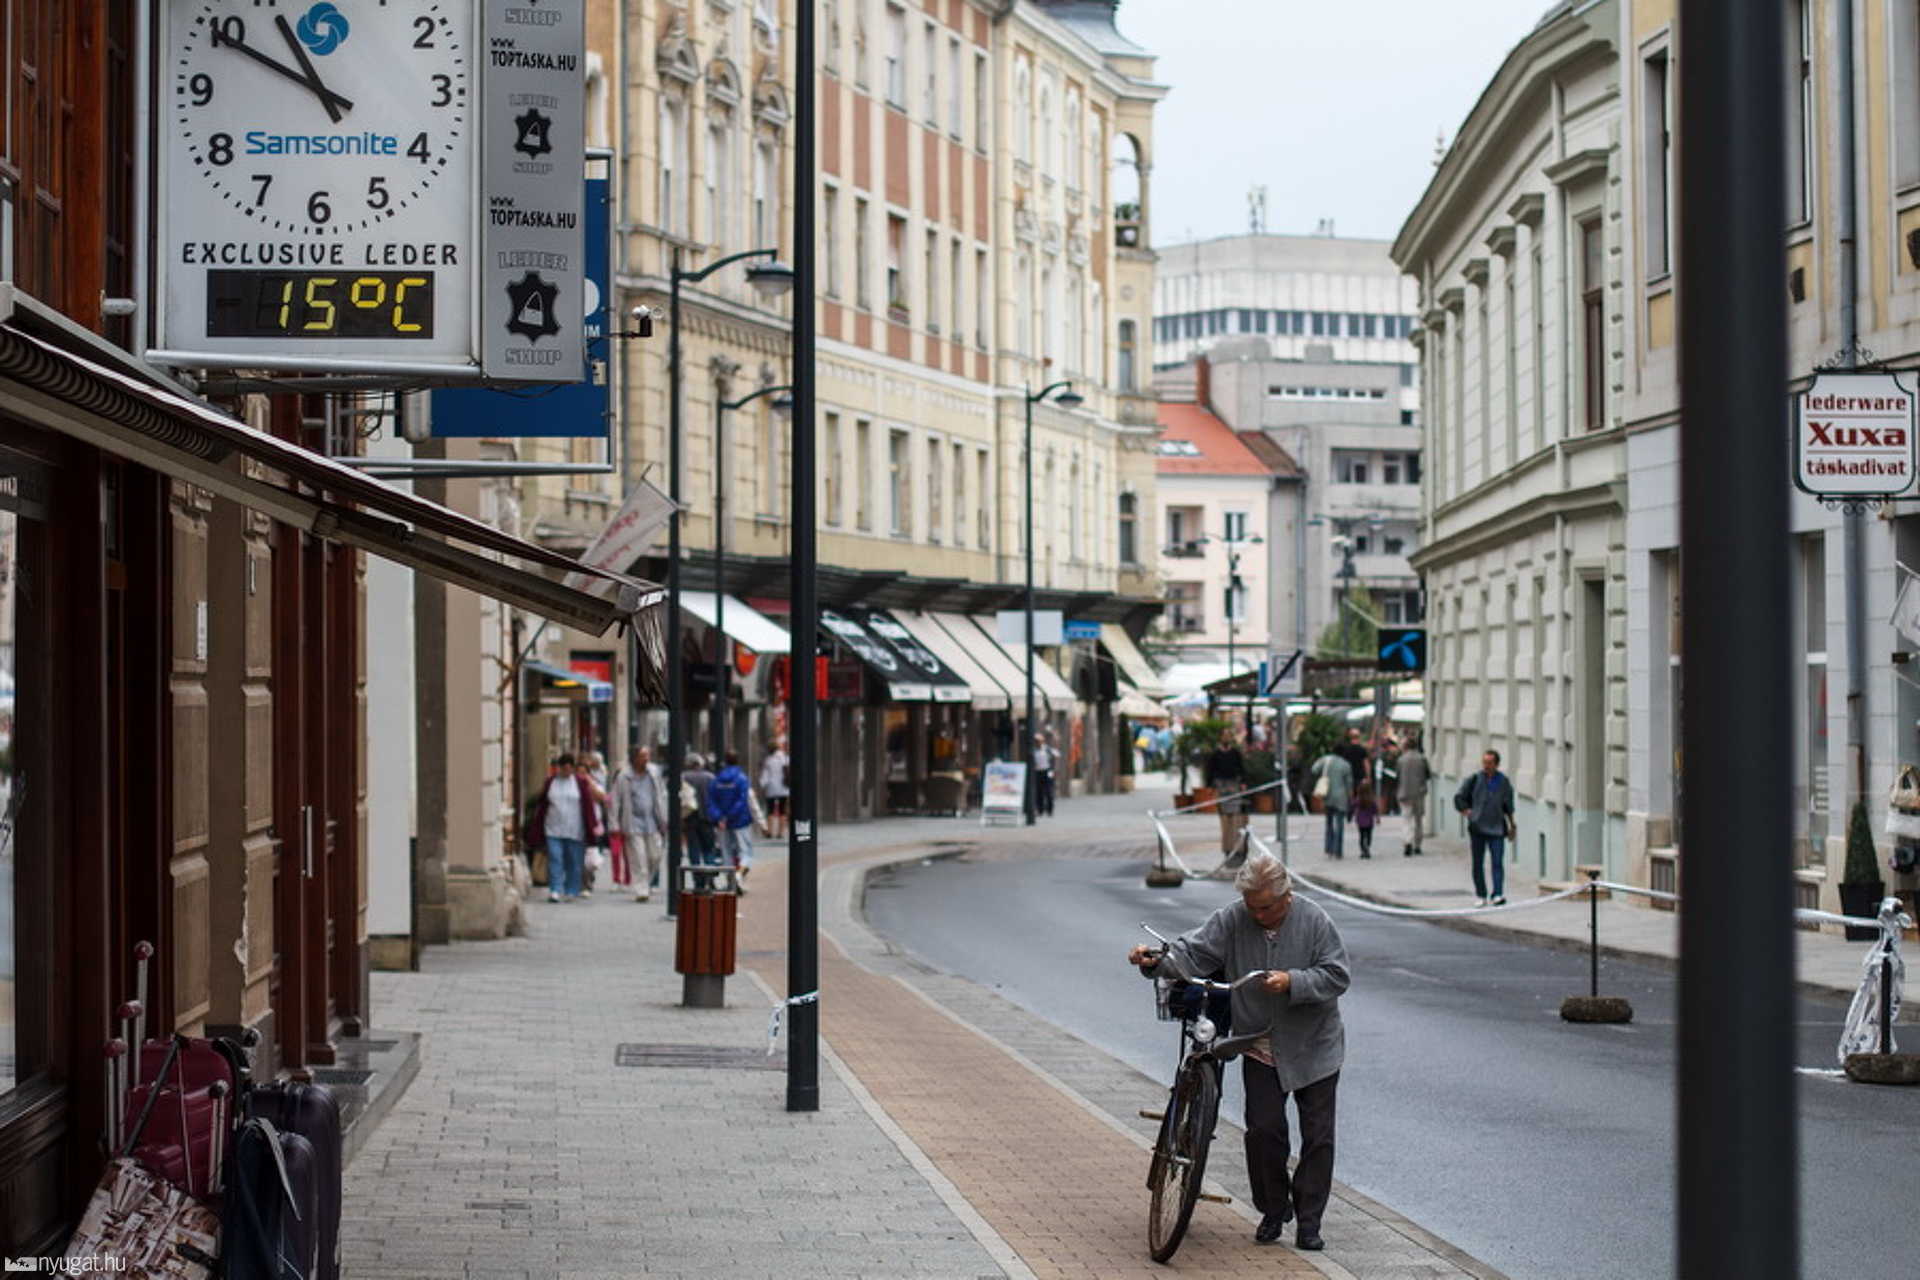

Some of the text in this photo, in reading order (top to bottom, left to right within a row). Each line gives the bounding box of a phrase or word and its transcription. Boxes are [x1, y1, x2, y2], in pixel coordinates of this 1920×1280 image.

[209, 15, 246, 48] 10
[413, 16, 435, 49] 2
[491, 51, 577, 71] TOPTASKA.HU
[190, 73, 214, 107] 9
[431, 74, 452, 107] 3
[208, 132, 234, 166] 8
[245, 131, 398, 155] Samsonite
[407, 132, 431, 164] 4
[252, 174, 273, 207] 7
[366, 177, 389, 209] 5
[307, 191, 331, 223] 6
[490, 209, 576, 229] TOPTASKA.HU
[182, 242, 458, 266] EXCLUSIVE LEDER
[1806, 393, 1906, 411] lederware
[1808, 421, 1906, 446] Xuxa
[1806, 458, 1906, 475] táskadivat
